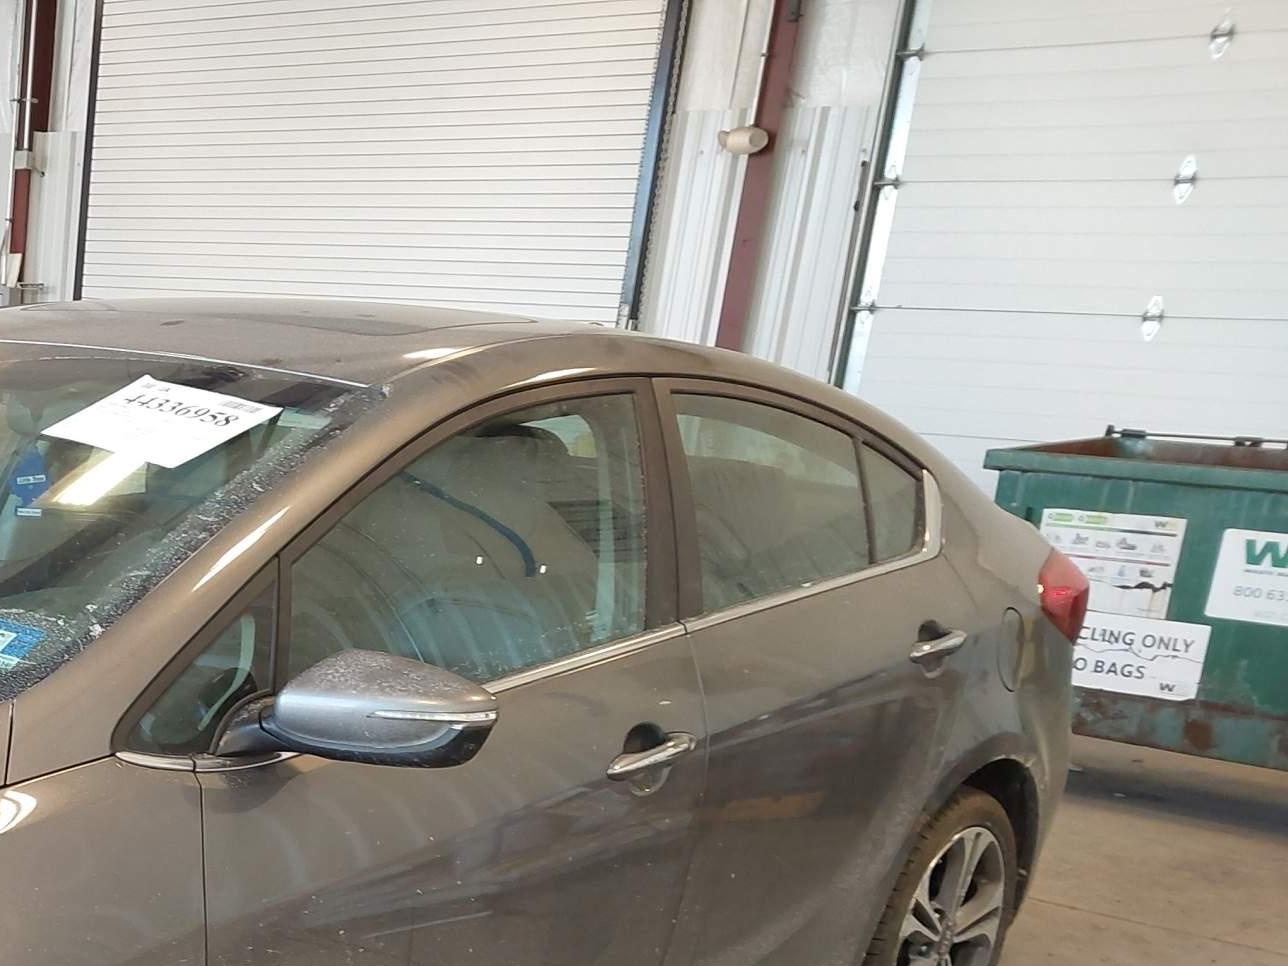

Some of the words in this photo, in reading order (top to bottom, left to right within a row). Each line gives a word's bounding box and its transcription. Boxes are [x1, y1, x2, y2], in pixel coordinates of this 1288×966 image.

[124, 394, 239, 426] 44336958
[1233, 585, 1262, 599] 800
[1266, 589, 1288, 602] 63
[1142, 634, 1194, 653] ONLY
[1073, 657, 1088, 671] O
[1094, 660, 1146, 679] BAGS
